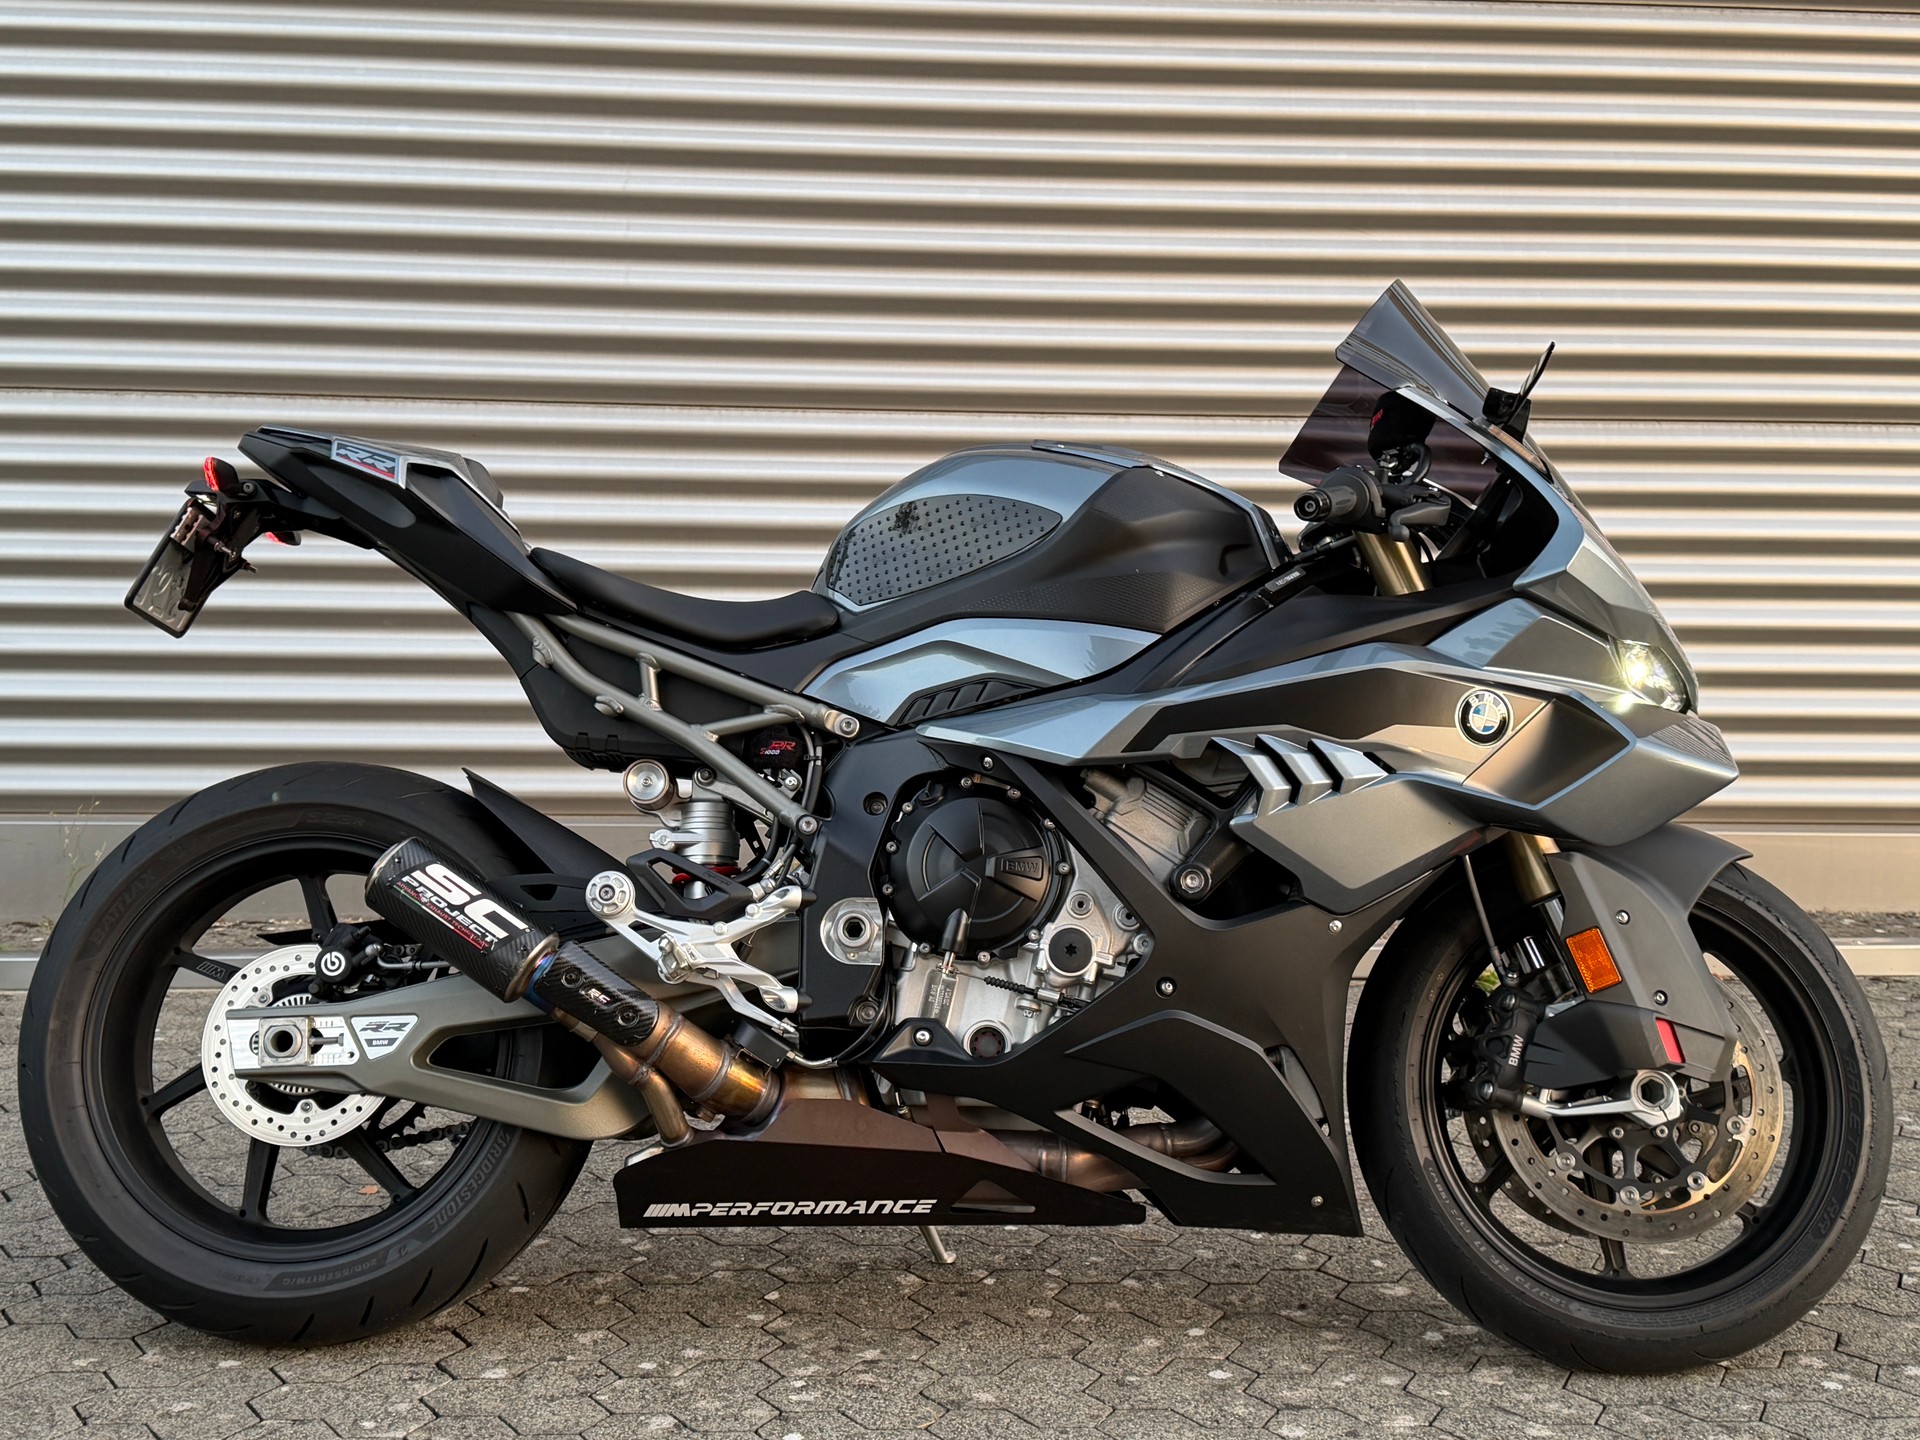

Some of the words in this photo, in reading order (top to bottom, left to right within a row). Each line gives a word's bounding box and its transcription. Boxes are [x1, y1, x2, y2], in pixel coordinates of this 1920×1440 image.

[336, 446, 396, 473] RR
[1468, 693, 1507, 718] BMW
[1006, 860, 1039, 873] BMW
[401, 875, 500, 943] PROJECT
[410, 863, 529, 940] SC
[1508, 1034, 1524, 1067] BMW
[1839, 1056, 1862, 1191] RACETEC
[427, 1129, 511, 1233] BRIDGESTONE
[1817, 1196, 1840, 1237] RR
